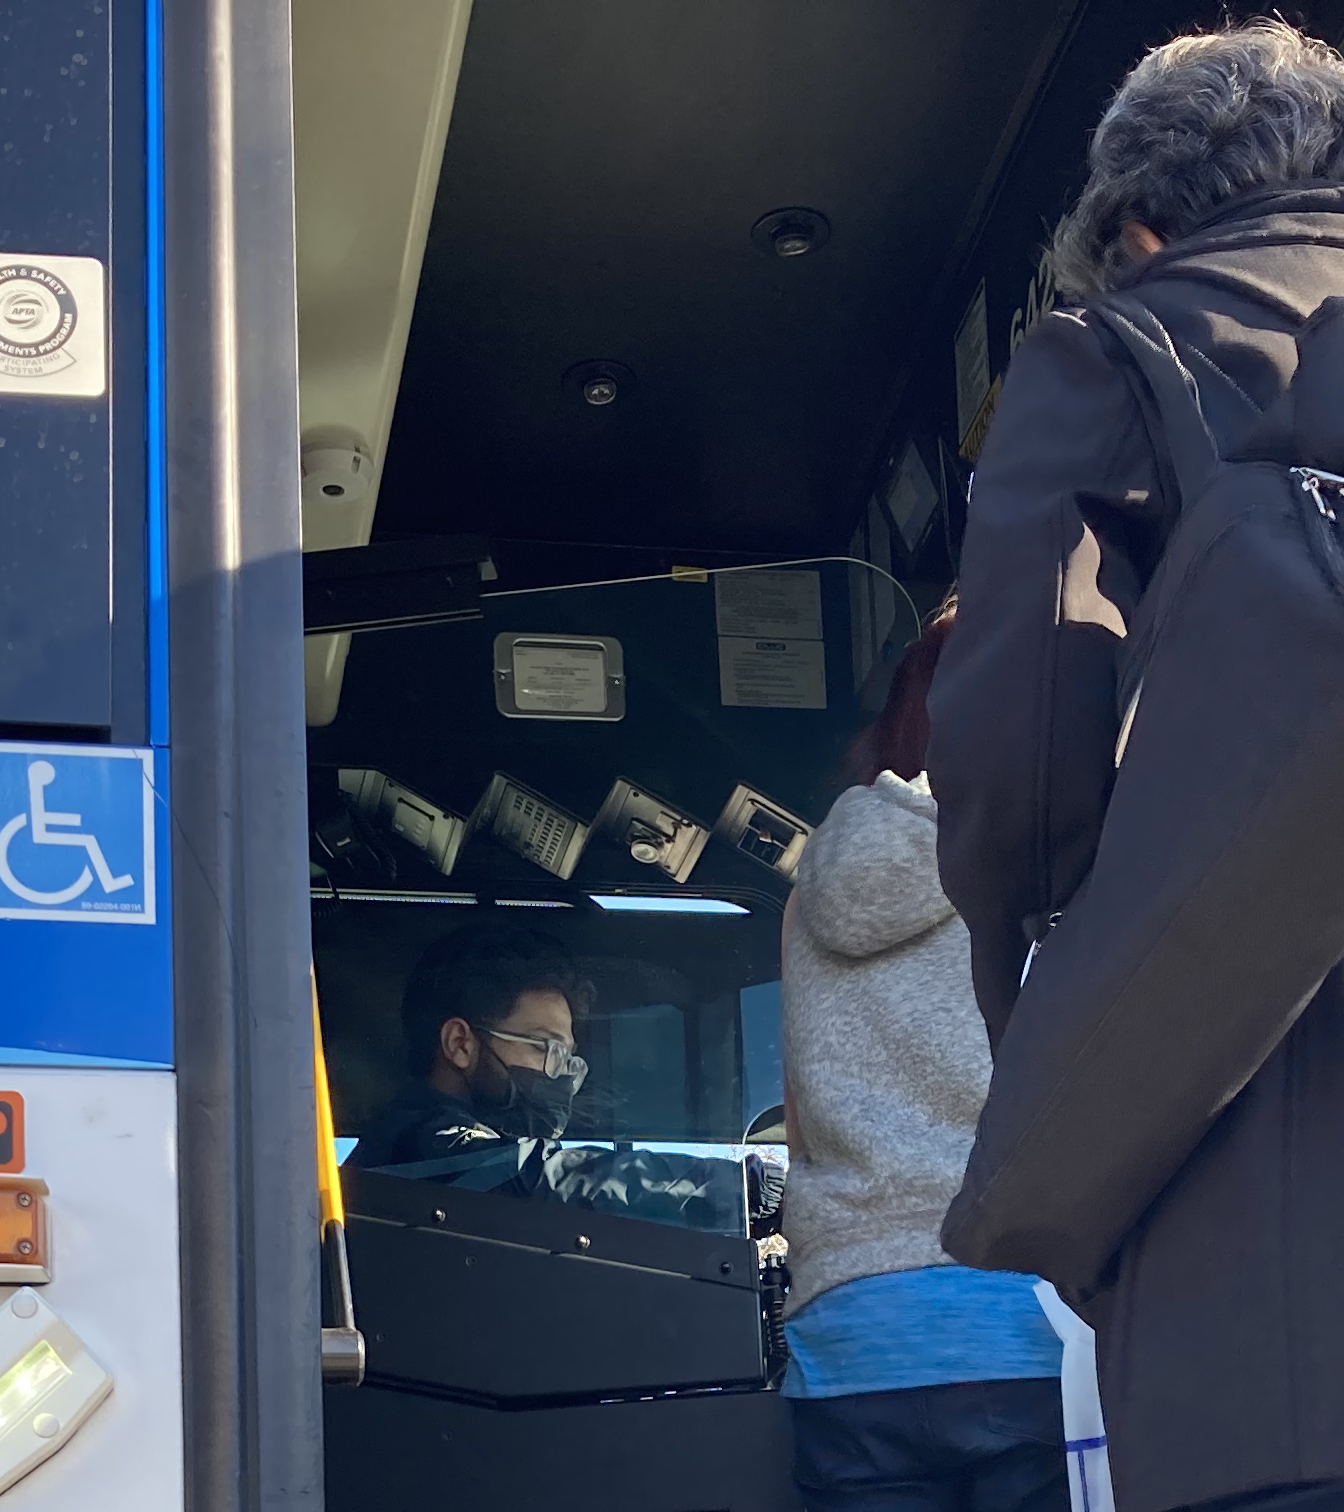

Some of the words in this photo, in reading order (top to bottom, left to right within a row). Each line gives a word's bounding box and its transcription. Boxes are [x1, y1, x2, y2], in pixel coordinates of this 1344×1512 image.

[19, 267, 28, 277] &
[31, 270, 67, 296] SAFETY
[11, 307, 35, 316] APTA
[38, 313, 73, 354] PROGRAM
[4, 365, 43, 374] SYSTEM
